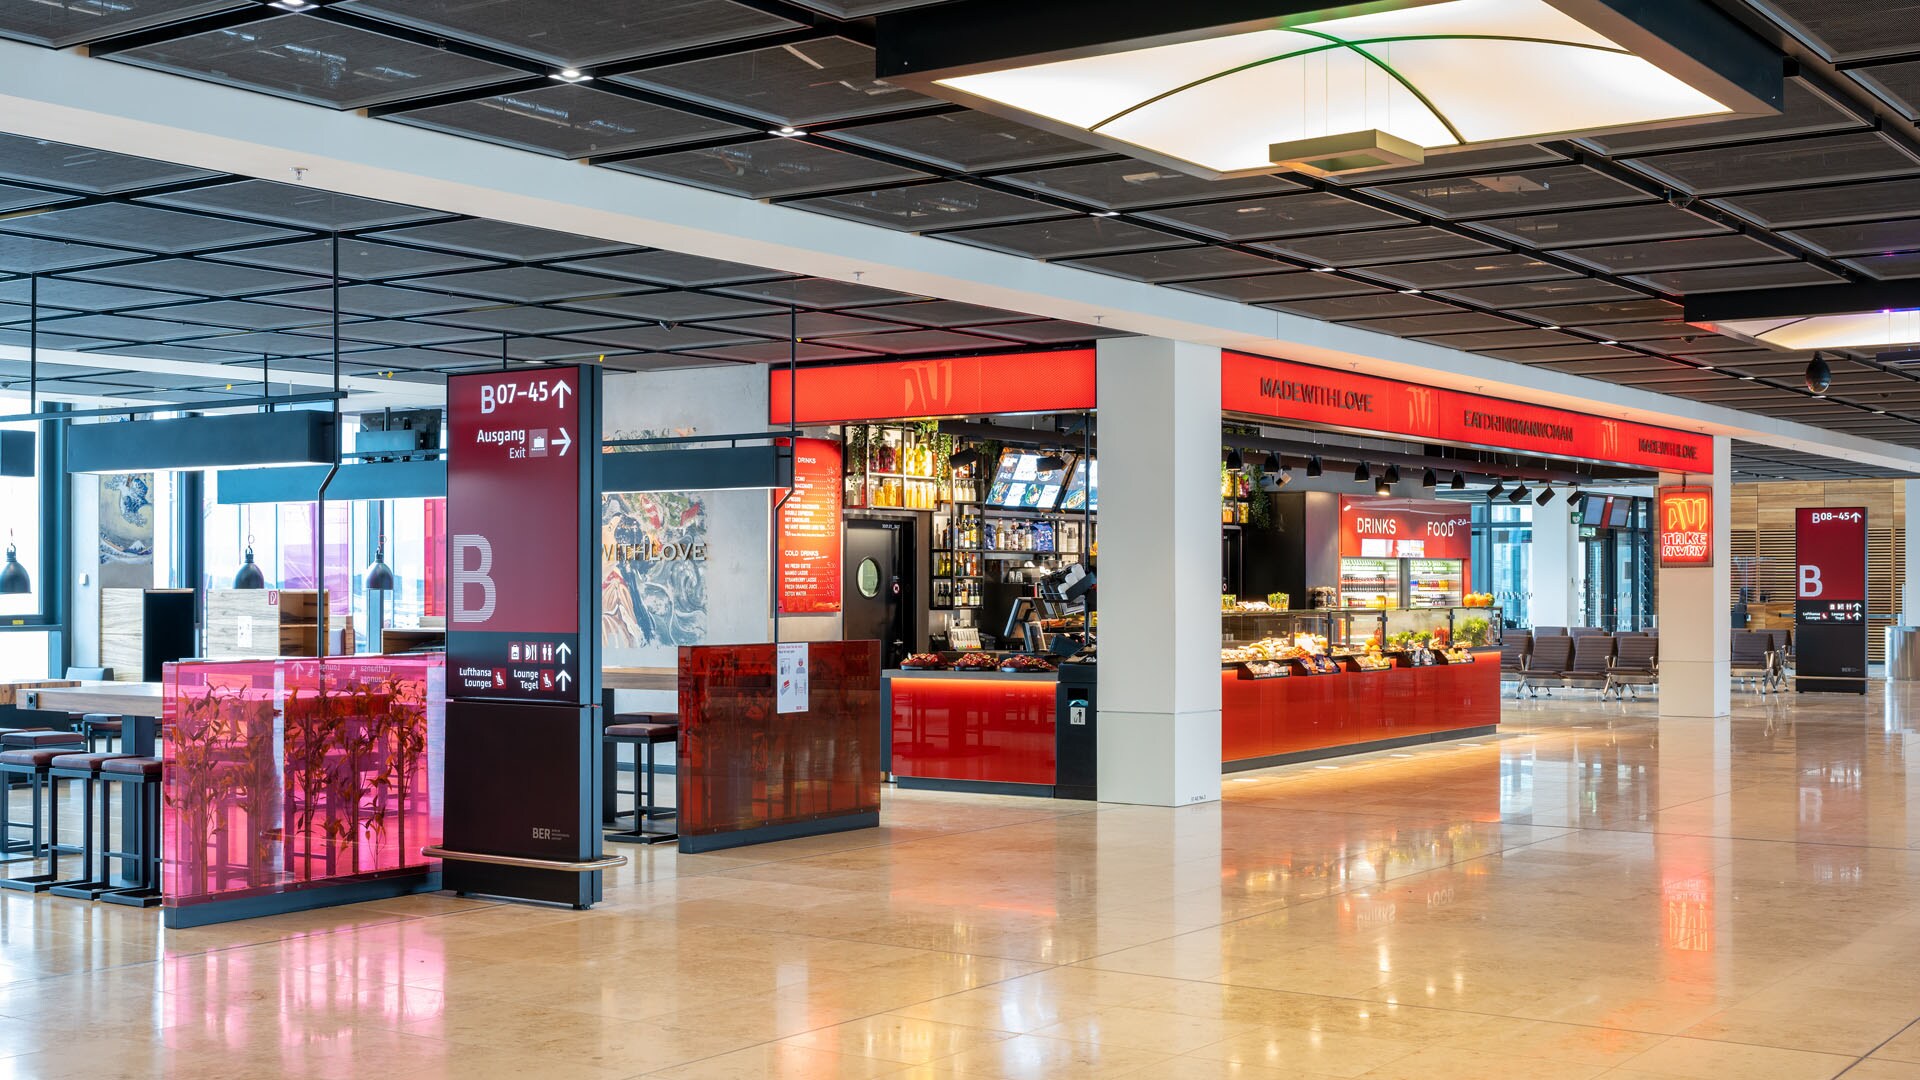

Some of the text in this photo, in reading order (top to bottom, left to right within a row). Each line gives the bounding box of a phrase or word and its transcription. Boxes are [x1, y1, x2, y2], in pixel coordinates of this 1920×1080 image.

[1260, 377, 1374, 413] MADEWITHLOVE
[1463, 409, 1574, 442] EATDRINKMANWOMAN
[476, 429, 526, 446] Ausgang
[509, 447, 526, 459] Exit
[1638, 437, 1698, 460] MADEWITHLOVE
[1356, 517, 1397, 535] DRINKS
[1427, 521, 1455, 537] FOOD
[1662, 532, 1708, 545] TAKE
[784, 549, 799, 557] COLD
[1662, 545, 1707, 557] AWAY
[453, 534, 496, 622] B
[1799, 565, 1823, 597] B
[459, 667, 492, 677] Lufthansa
[513, 669, 539, 681] Lounge
[464, 679, 492, 690] Lounges
[520, 680, 539, 692] Tegel
[532, 827, 551, 840] BER
